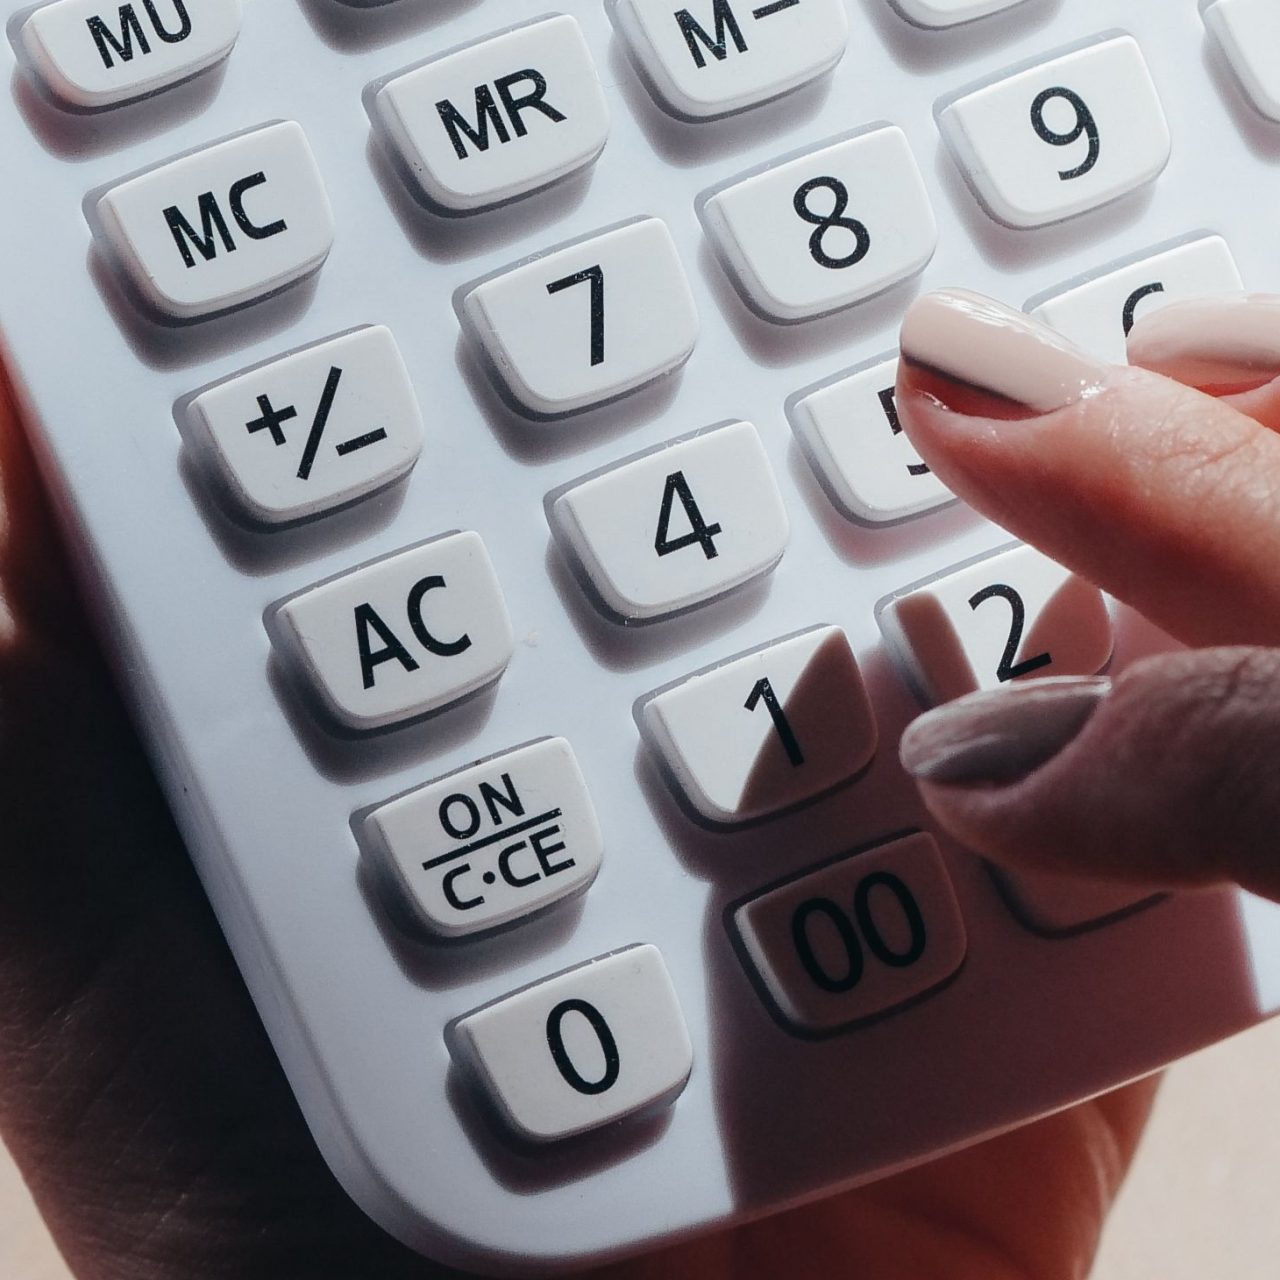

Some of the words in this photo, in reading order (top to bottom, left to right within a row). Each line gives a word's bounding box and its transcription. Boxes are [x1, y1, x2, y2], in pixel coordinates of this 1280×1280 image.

[434, 68, 568, 160] MR
[1030, 87, 1100, 181] 9
[162, 171, 288, 269] MC
[793, 176, 871, 270] 8
[546, 264, 605, 367] 7
[245, 365, 388, 481] +/-
[654, 470, 722, 560] 4
[353, 575, 473, 690] AC
[967, 583, 1052, 683] 2
[743, 676, 805, 767] 1
[438, 772, 526, 841] ON
[788, 870, 928, 996] 00
[545, 998, 621, 1096] 0
